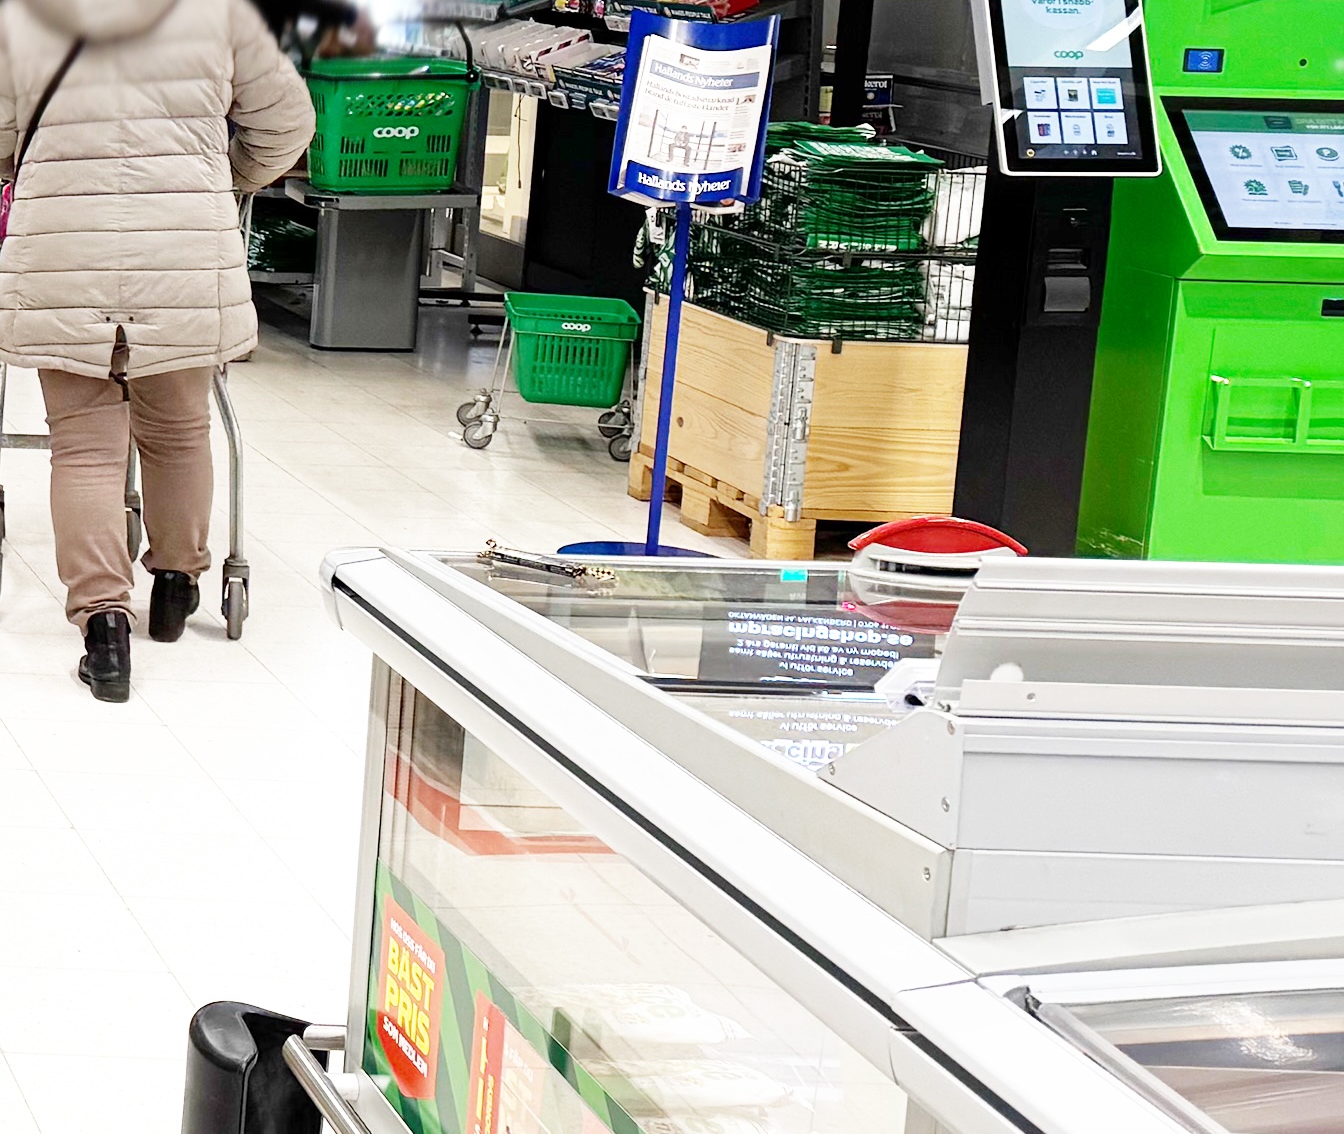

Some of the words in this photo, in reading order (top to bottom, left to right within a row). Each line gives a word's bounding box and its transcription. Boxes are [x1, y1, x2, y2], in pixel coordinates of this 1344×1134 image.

[1054, 49, 1084, 61] coop
[654, 62, 693, 83] Hallands
[694, 75, 733, 87] Nyheter
[373, 125, 419, 140] coop
[638, 171, 686, 192] Hallands
[561, 321, 591, 333] coop
[387, 936, 435, 1011] BÄST
[384, 974, 430, 1056] PRIS
[382, 1015, 399, 1043] SOM
